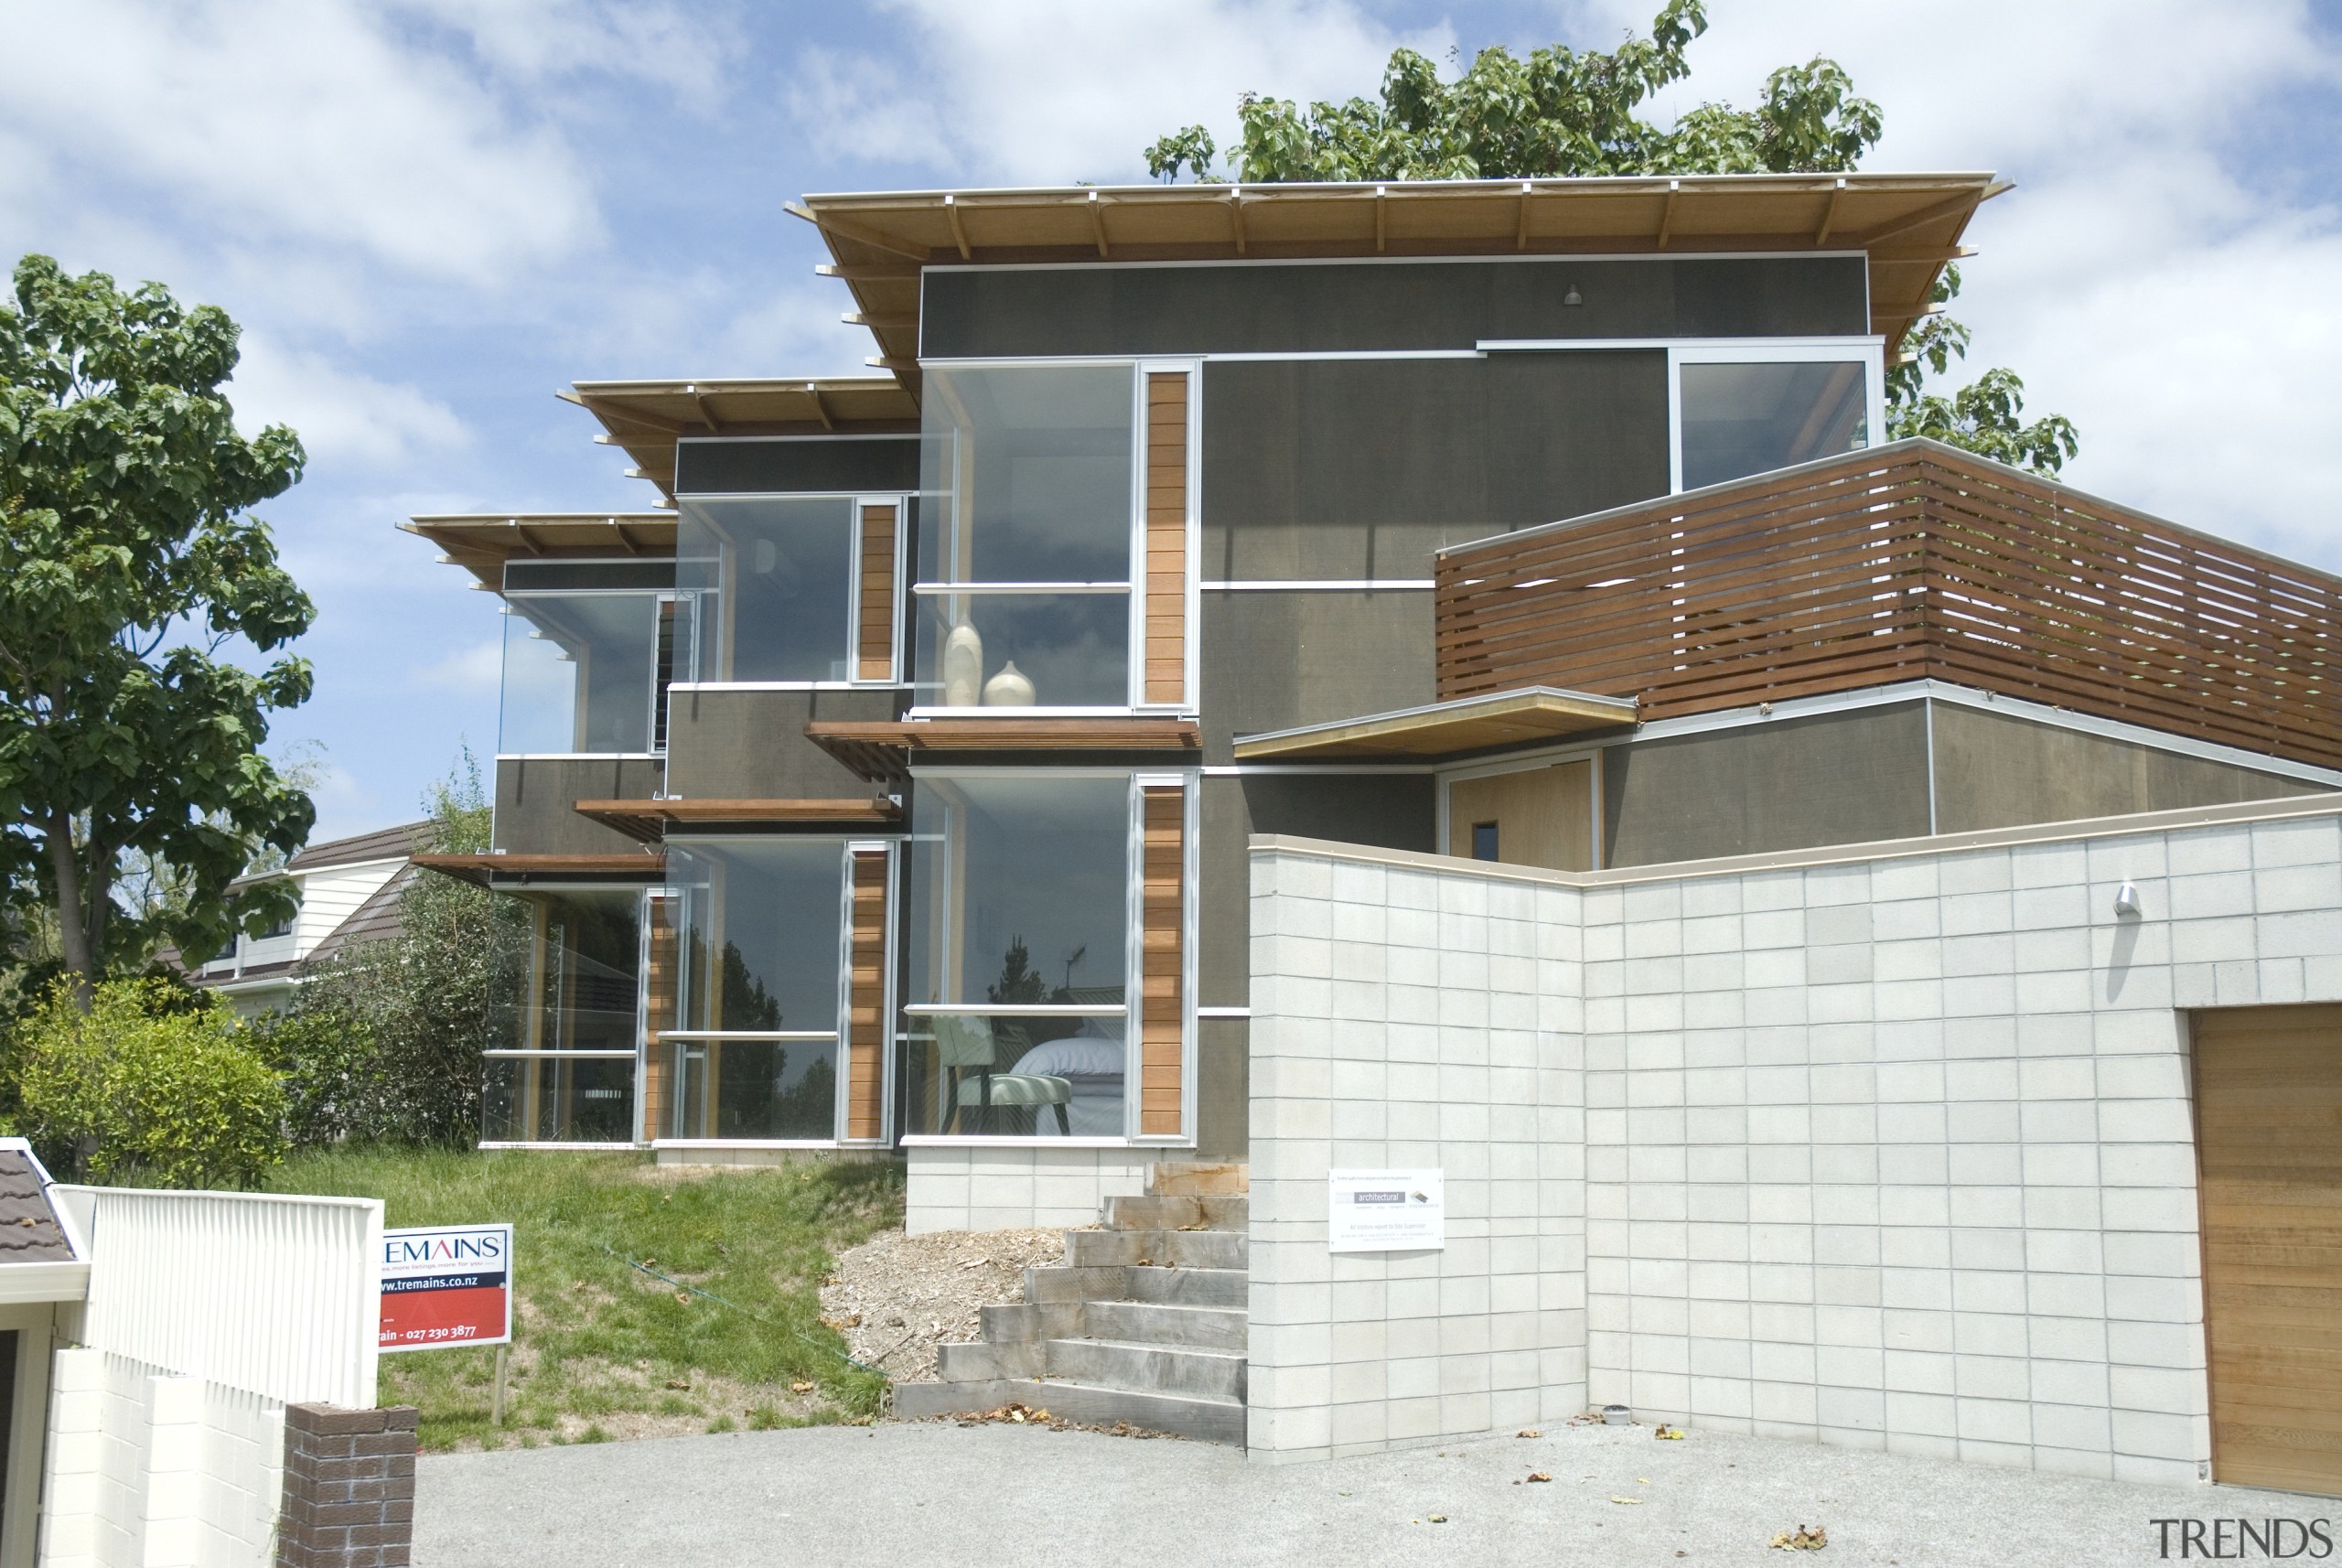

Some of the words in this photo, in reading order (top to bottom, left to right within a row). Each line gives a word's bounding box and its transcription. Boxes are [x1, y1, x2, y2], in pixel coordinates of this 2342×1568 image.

[1359, 1192, 1399, 1201] architectural
[382, 1237, 500, 1263] EMAINS
[380, 1329, 397, 1341] ain
[406, 1329, 426, 1341] 027
[428, 1327, 449, 1339] 230
[450, 1325, 477, 1338] 3877
